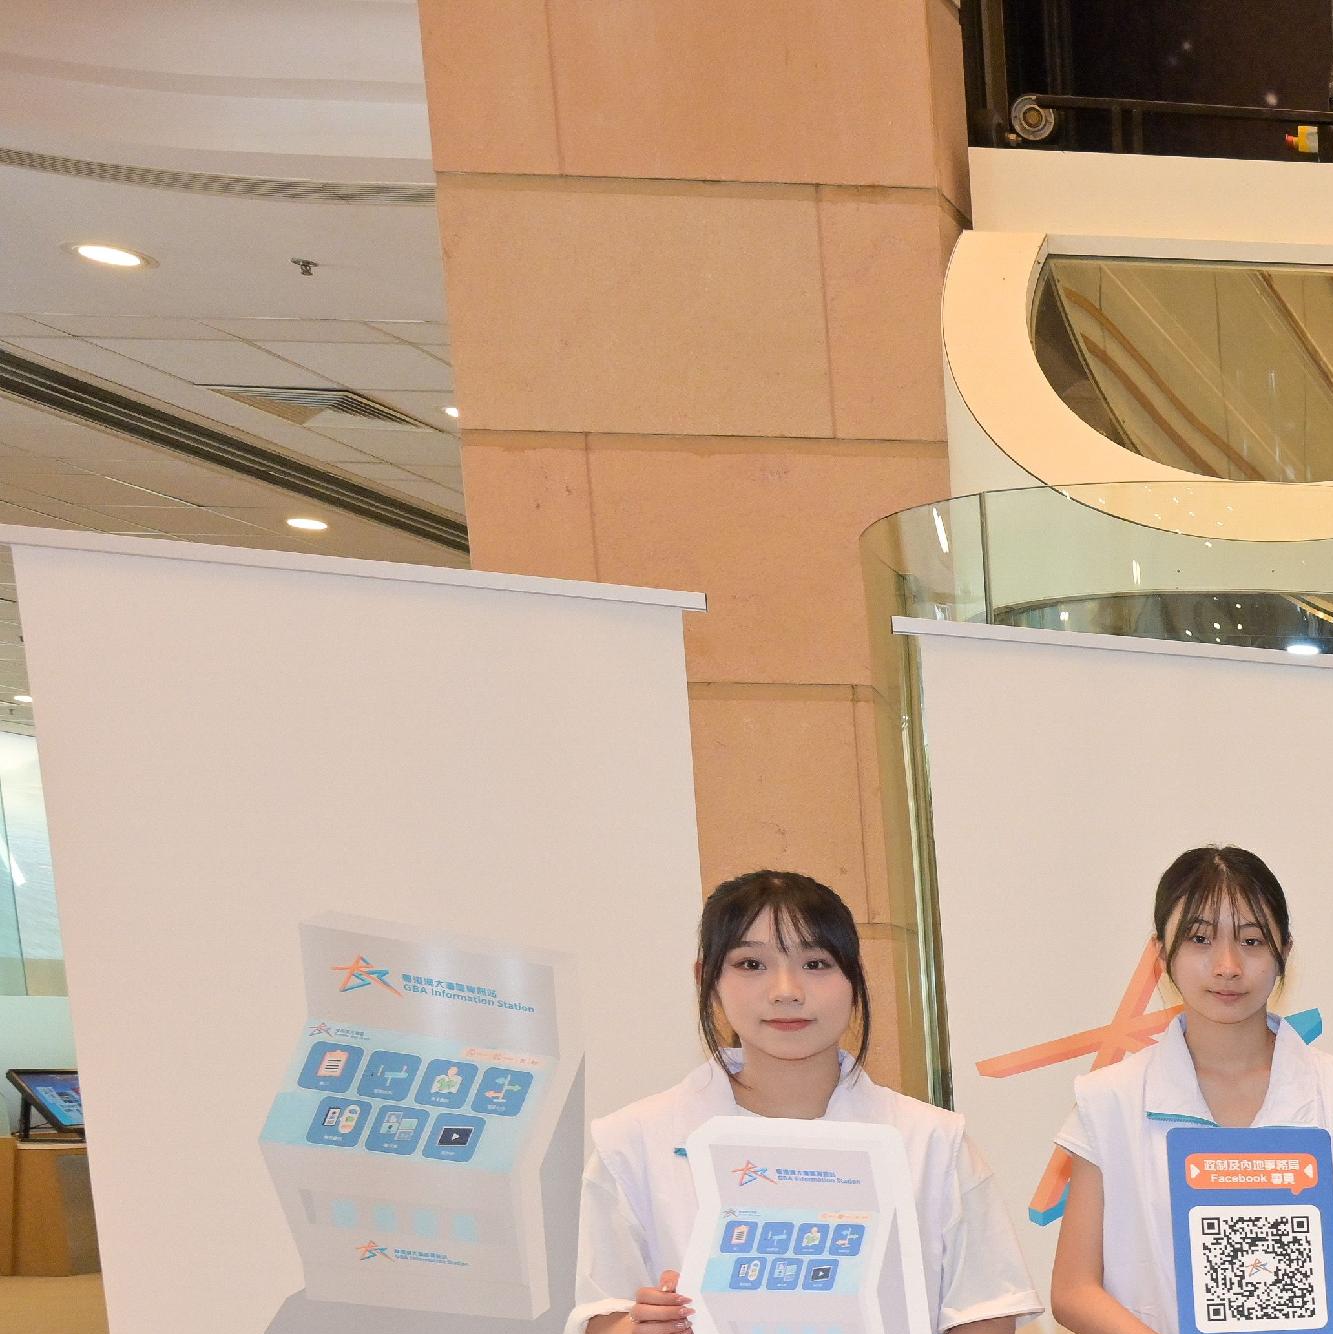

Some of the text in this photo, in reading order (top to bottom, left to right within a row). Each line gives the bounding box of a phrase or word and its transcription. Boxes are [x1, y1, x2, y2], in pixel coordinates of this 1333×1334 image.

[403, 984, 535, 1013] GBA Information Station
[1211, 1174, 1267, 1183] Facebook
